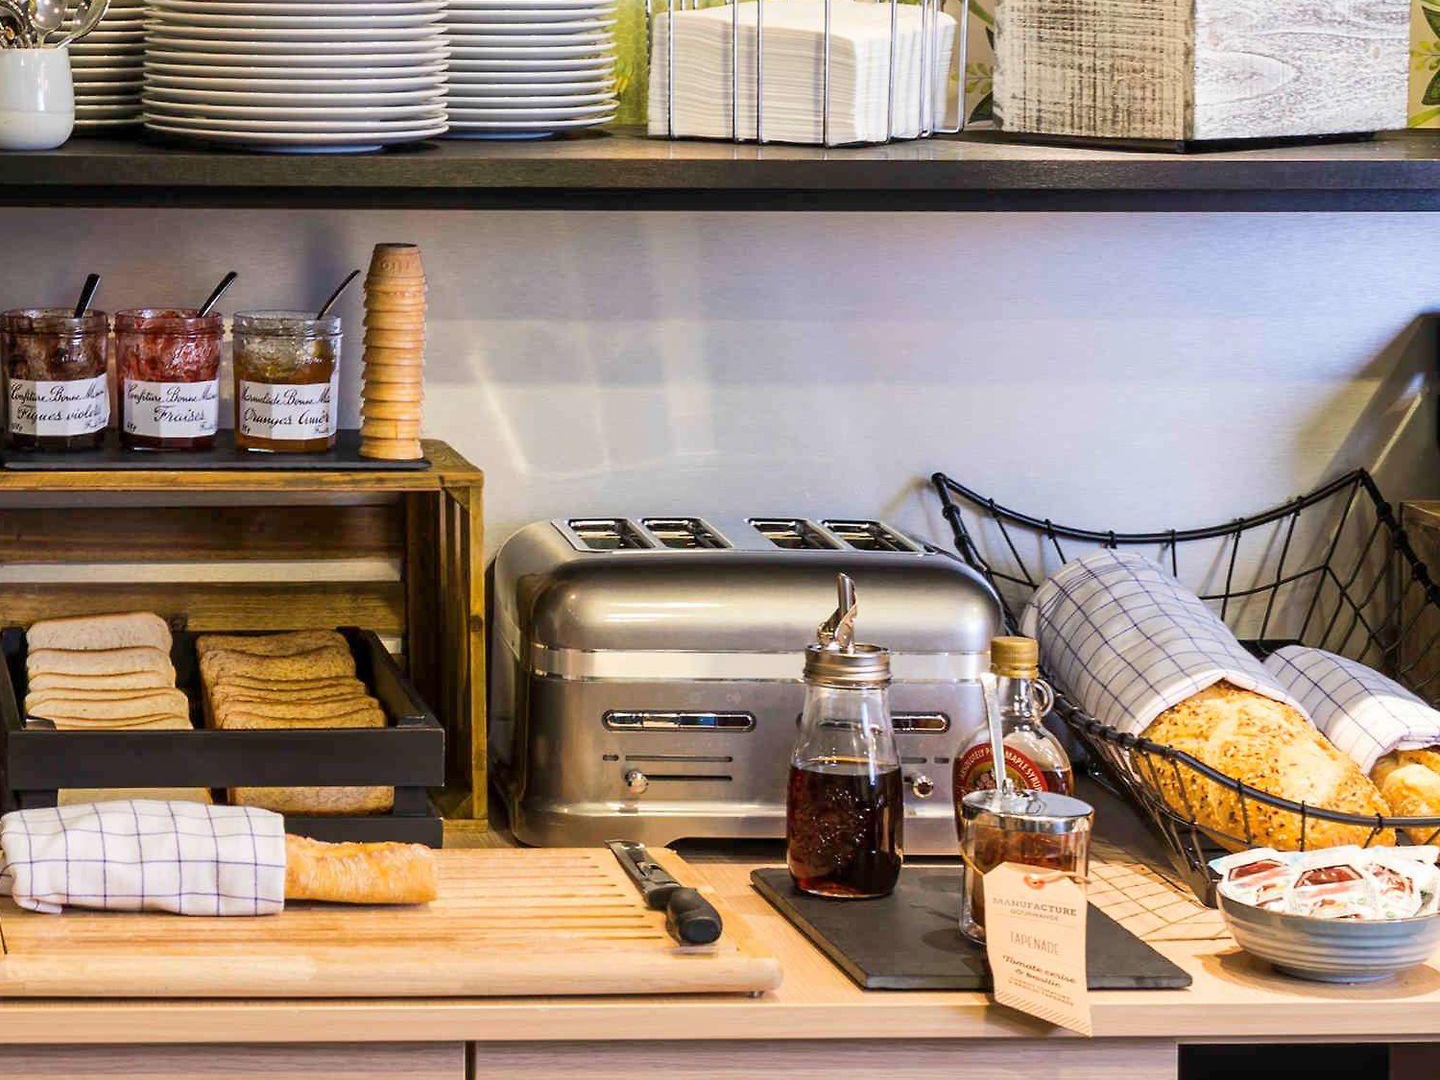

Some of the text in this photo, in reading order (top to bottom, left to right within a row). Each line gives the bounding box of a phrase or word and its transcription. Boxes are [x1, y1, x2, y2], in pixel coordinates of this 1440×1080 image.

[50, 385, 81, 402] Bonne
[166, 385, 197, 403] Bonne
[284, 388, 314, 405] Bonne
[17, 404, 62, 424] Figues
[154, 405, 205, 422] Fraises
[243, 408, 292, 428] Oranges
[1005, 751, 1028, 771] MAPLE
[992, 897, 1077, 917] MANUFACTURE
[1010, 931, 1061, 956] TAPENADE
[1003, 954, 1042, 973] Tomate
